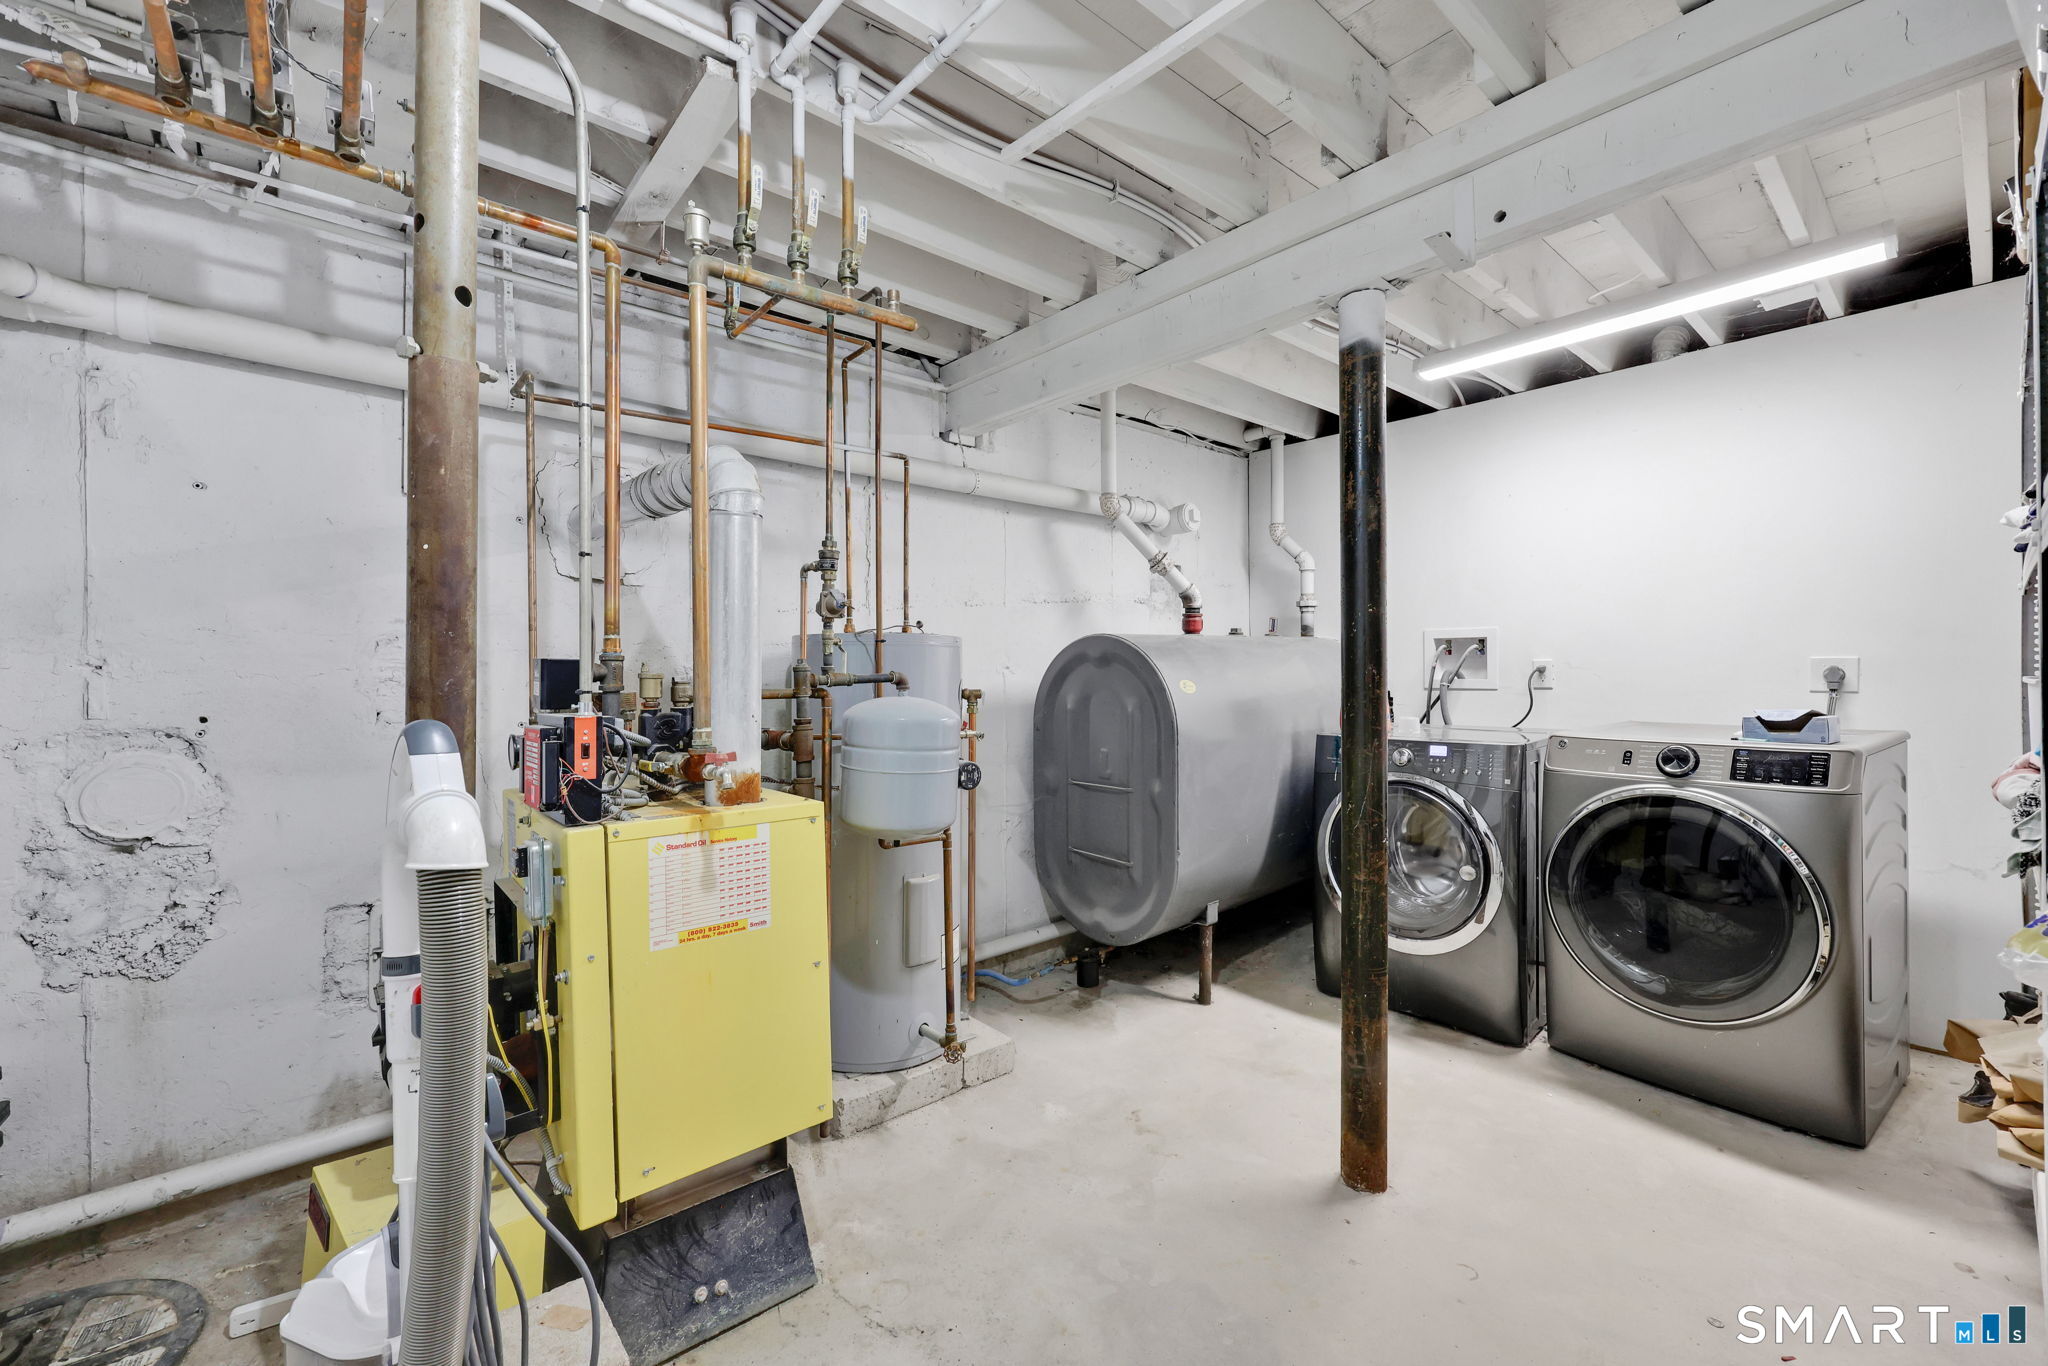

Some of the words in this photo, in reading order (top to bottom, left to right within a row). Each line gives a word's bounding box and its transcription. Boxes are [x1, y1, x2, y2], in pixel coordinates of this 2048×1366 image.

[666, 840, 697, 851] Standard
[698, 839, 706, 847] Oil
[749, 920, 768, 928] Smith
[687, 928, 706, 937] (800)
